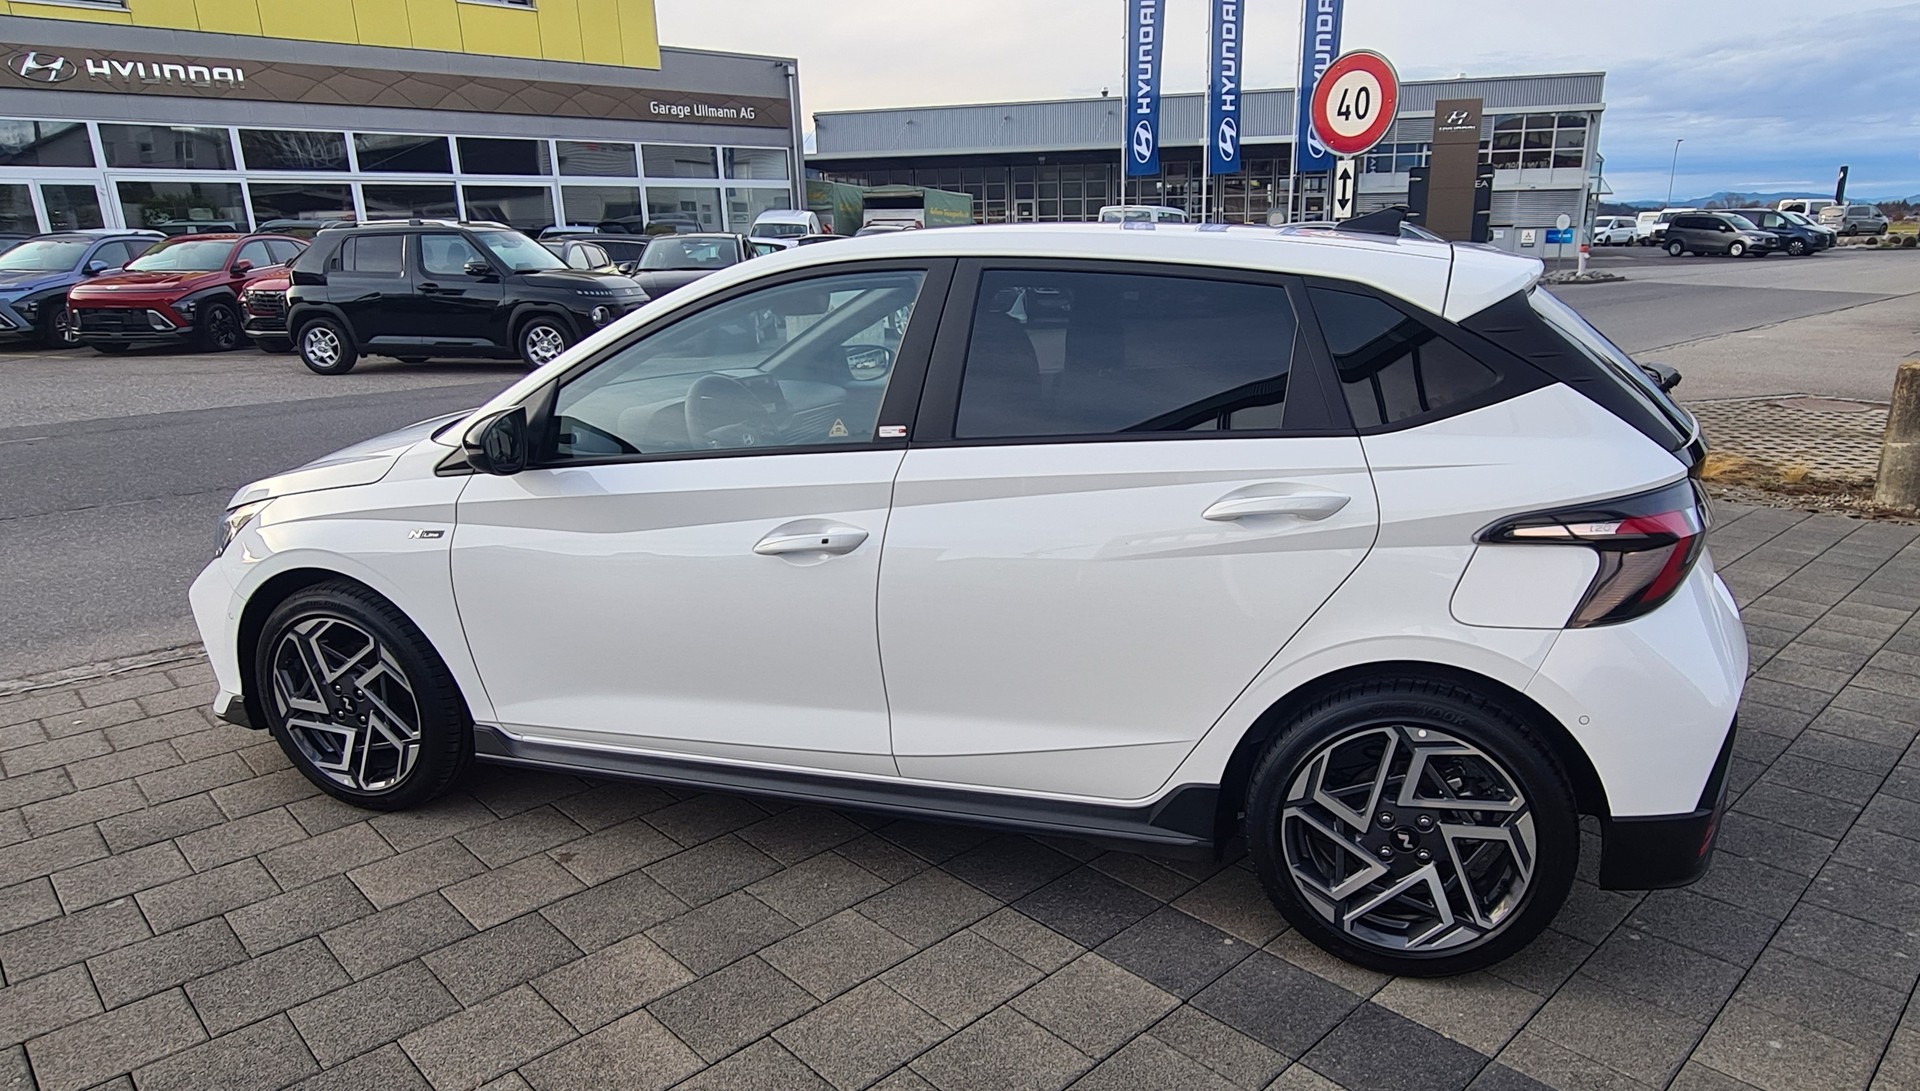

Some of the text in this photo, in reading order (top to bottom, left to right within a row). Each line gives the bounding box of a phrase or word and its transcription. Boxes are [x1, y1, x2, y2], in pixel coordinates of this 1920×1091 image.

[1137, 0, 1156, 114] HYUNDAI
[85, 58, 247, 90] HYUNDAI
[650, 101, 756, 119] Garage Ullmann AG
[1336, 86, 1371, 121] 40
